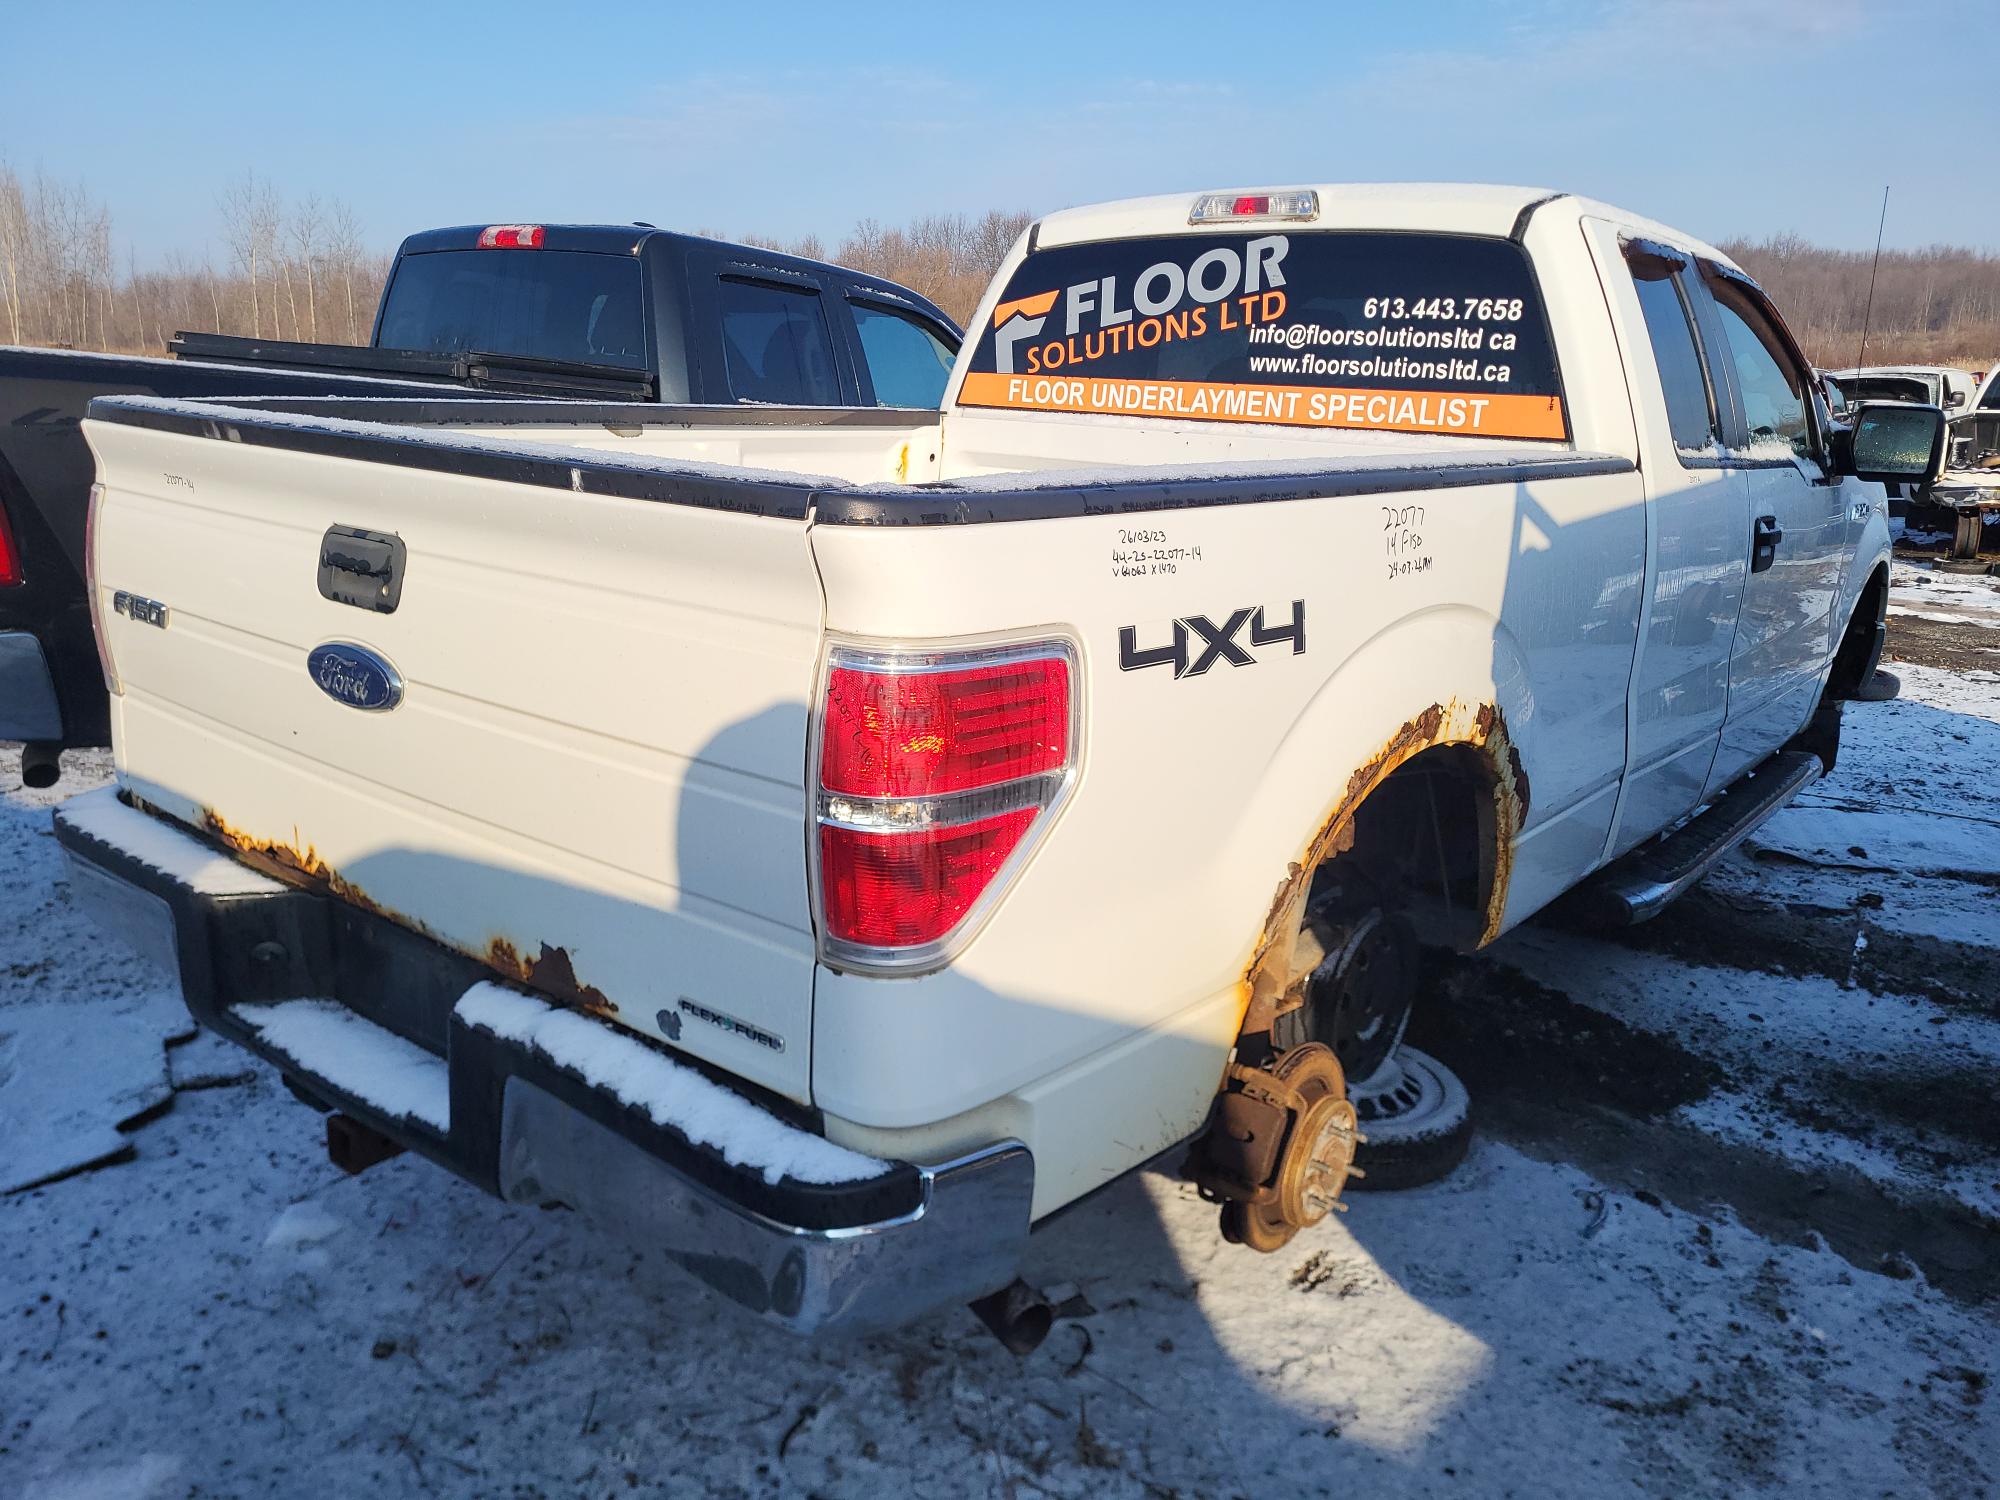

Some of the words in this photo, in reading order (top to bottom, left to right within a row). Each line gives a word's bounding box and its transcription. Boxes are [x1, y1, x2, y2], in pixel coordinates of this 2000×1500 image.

[1066, 235, 1289, 335] FLOOR
[1364, 298, 1523, 321] 613.443.7658
[1027, 307, 1206, 374] SOLUTIONS
[1220, 291, 1287, 330] LTD
[1249, 324, 1483, 349] info@floorsolutionsltd
[1489, 332, 1516, 350] ca
[1250, 354, 1511, 382] www.floorsolutionsltd.ca
[1008, 379, 1085, 407] FLOOR
[1091, 383, 1301, 419] UNDERLAYMENT
[1308, 393, 1489, 428] SPECIALIST
[1118, 529, 1167, 544] 26/03/23
[1382, 505, 1424, 531] 22077
[320, 653, 370, 706] Ford
[680, 999, 724, 1025] FLEX
[735, 1025, 781, 1050] FUEL
